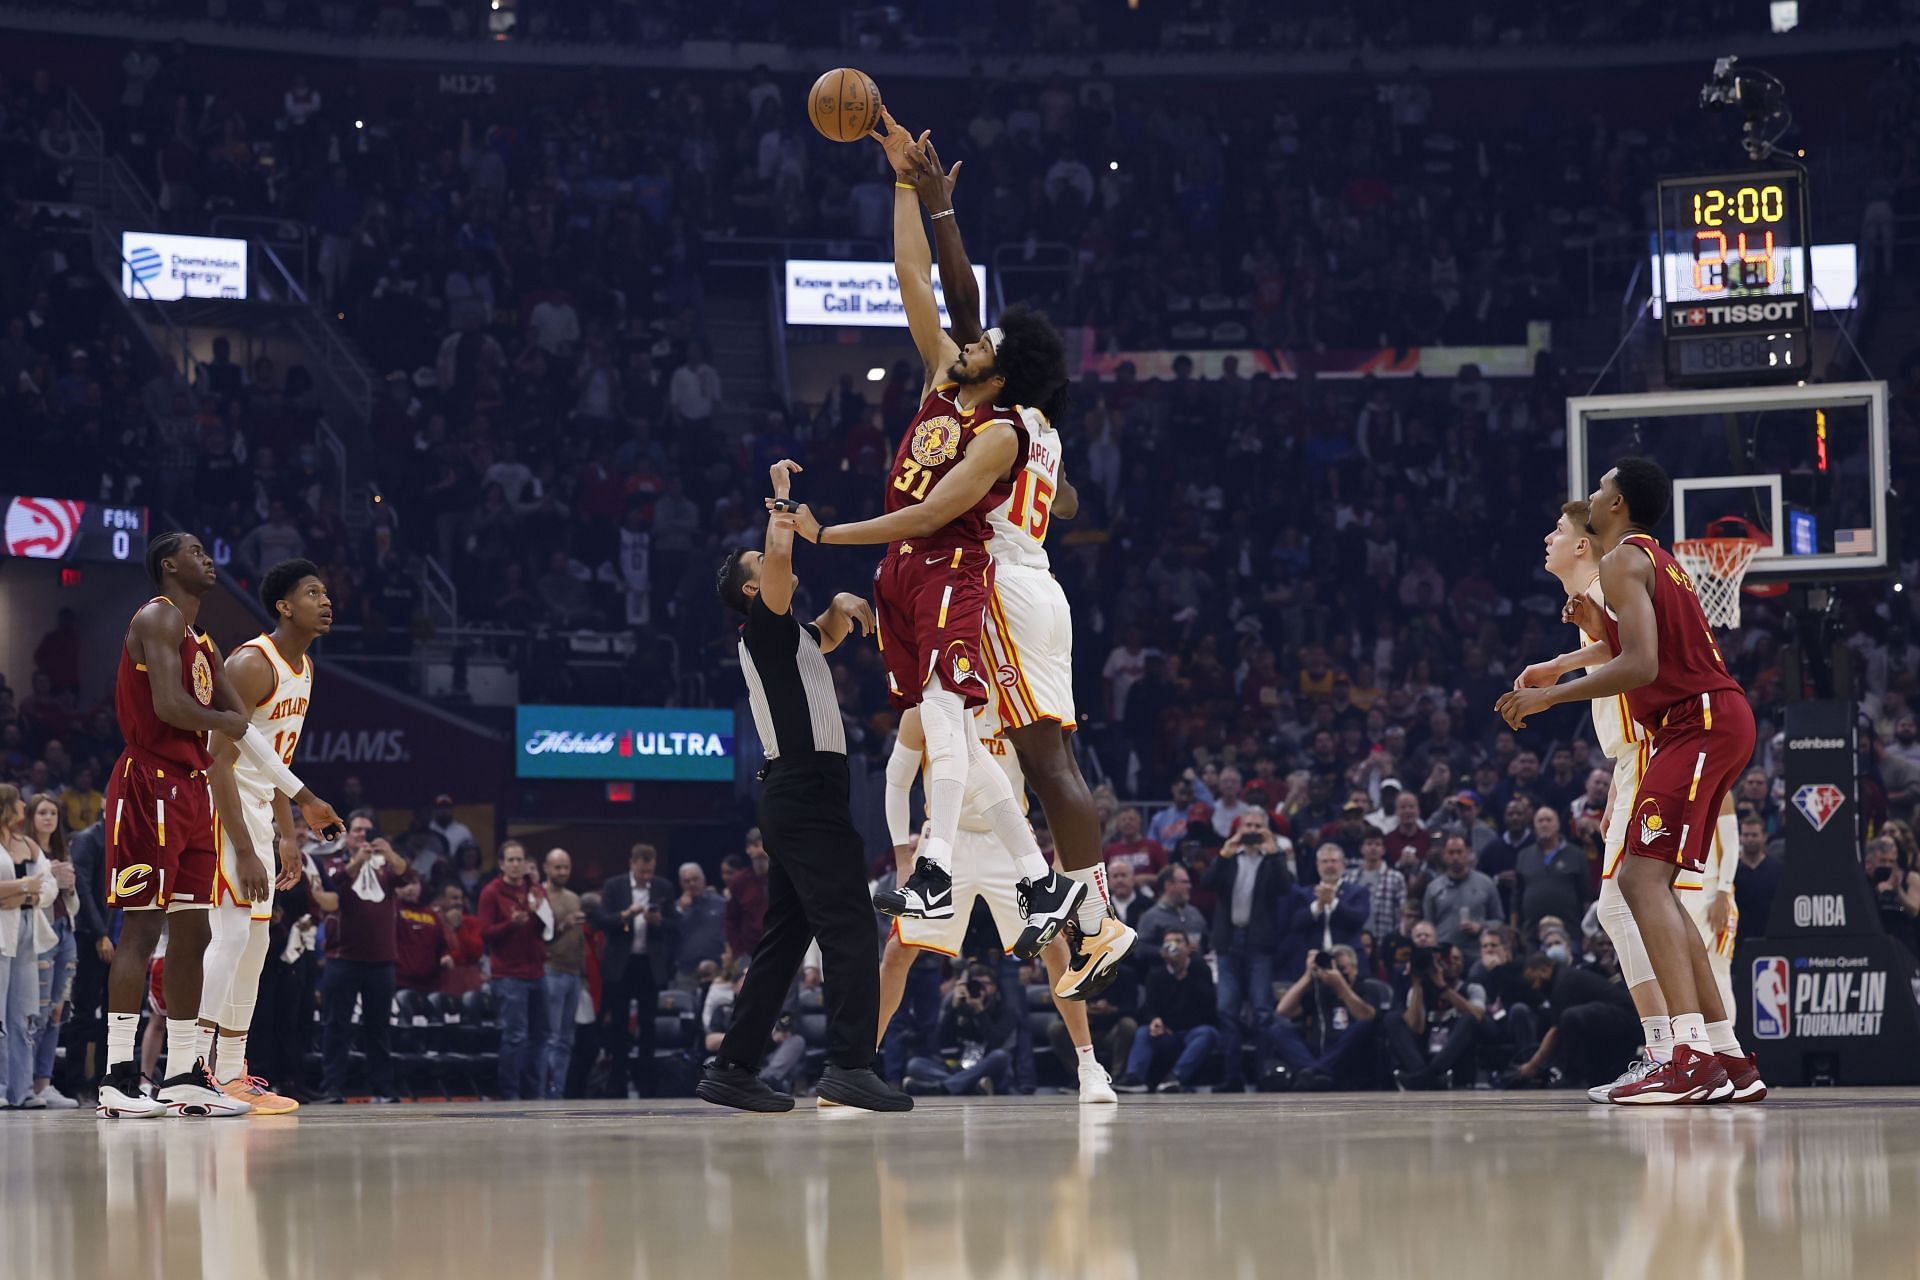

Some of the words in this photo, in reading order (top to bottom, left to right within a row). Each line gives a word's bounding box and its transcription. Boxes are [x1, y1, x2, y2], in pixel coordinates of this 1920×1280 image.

[1694, 186, 1783, 226] 12:00
[172, 254, 239, 268] Dominion
[1693, 230, 1775, 293] 24
[172, 269, 221, 284] Energy
[795, 277, 833, 289] Know
[838, 279, 883, 290] what's
[823, 293, 861, 312] Call
[866, 300, 904, 313] befor
[1707, 301, 1798, 325] TISSOT
[1028, 442, 1057, 477] APELA
[894, 457, 933, 500] 31
[1007, 467, 1054, 543] 15
[103, 508, 139, 530] FG%
[112, 530, 130, 560] 0
[268, 697, 308, 720] ATLANT
[274, 729, 297, 765] 12
[299, 730, 411, 763] LIAMS.
[636, 731, 725, 756] ULTRA
[1789, 737, 1845, 750] coinbase
[1794, 894, 1846, 927] @NBA
[1808, 957, 1836, 967] Meta
[1836, 956, 1869, 968] Quest
[1794, 971, 1887, 1014] PLAY-IN
[1796, 1012, 1883, 1037] TOURNAMENT
